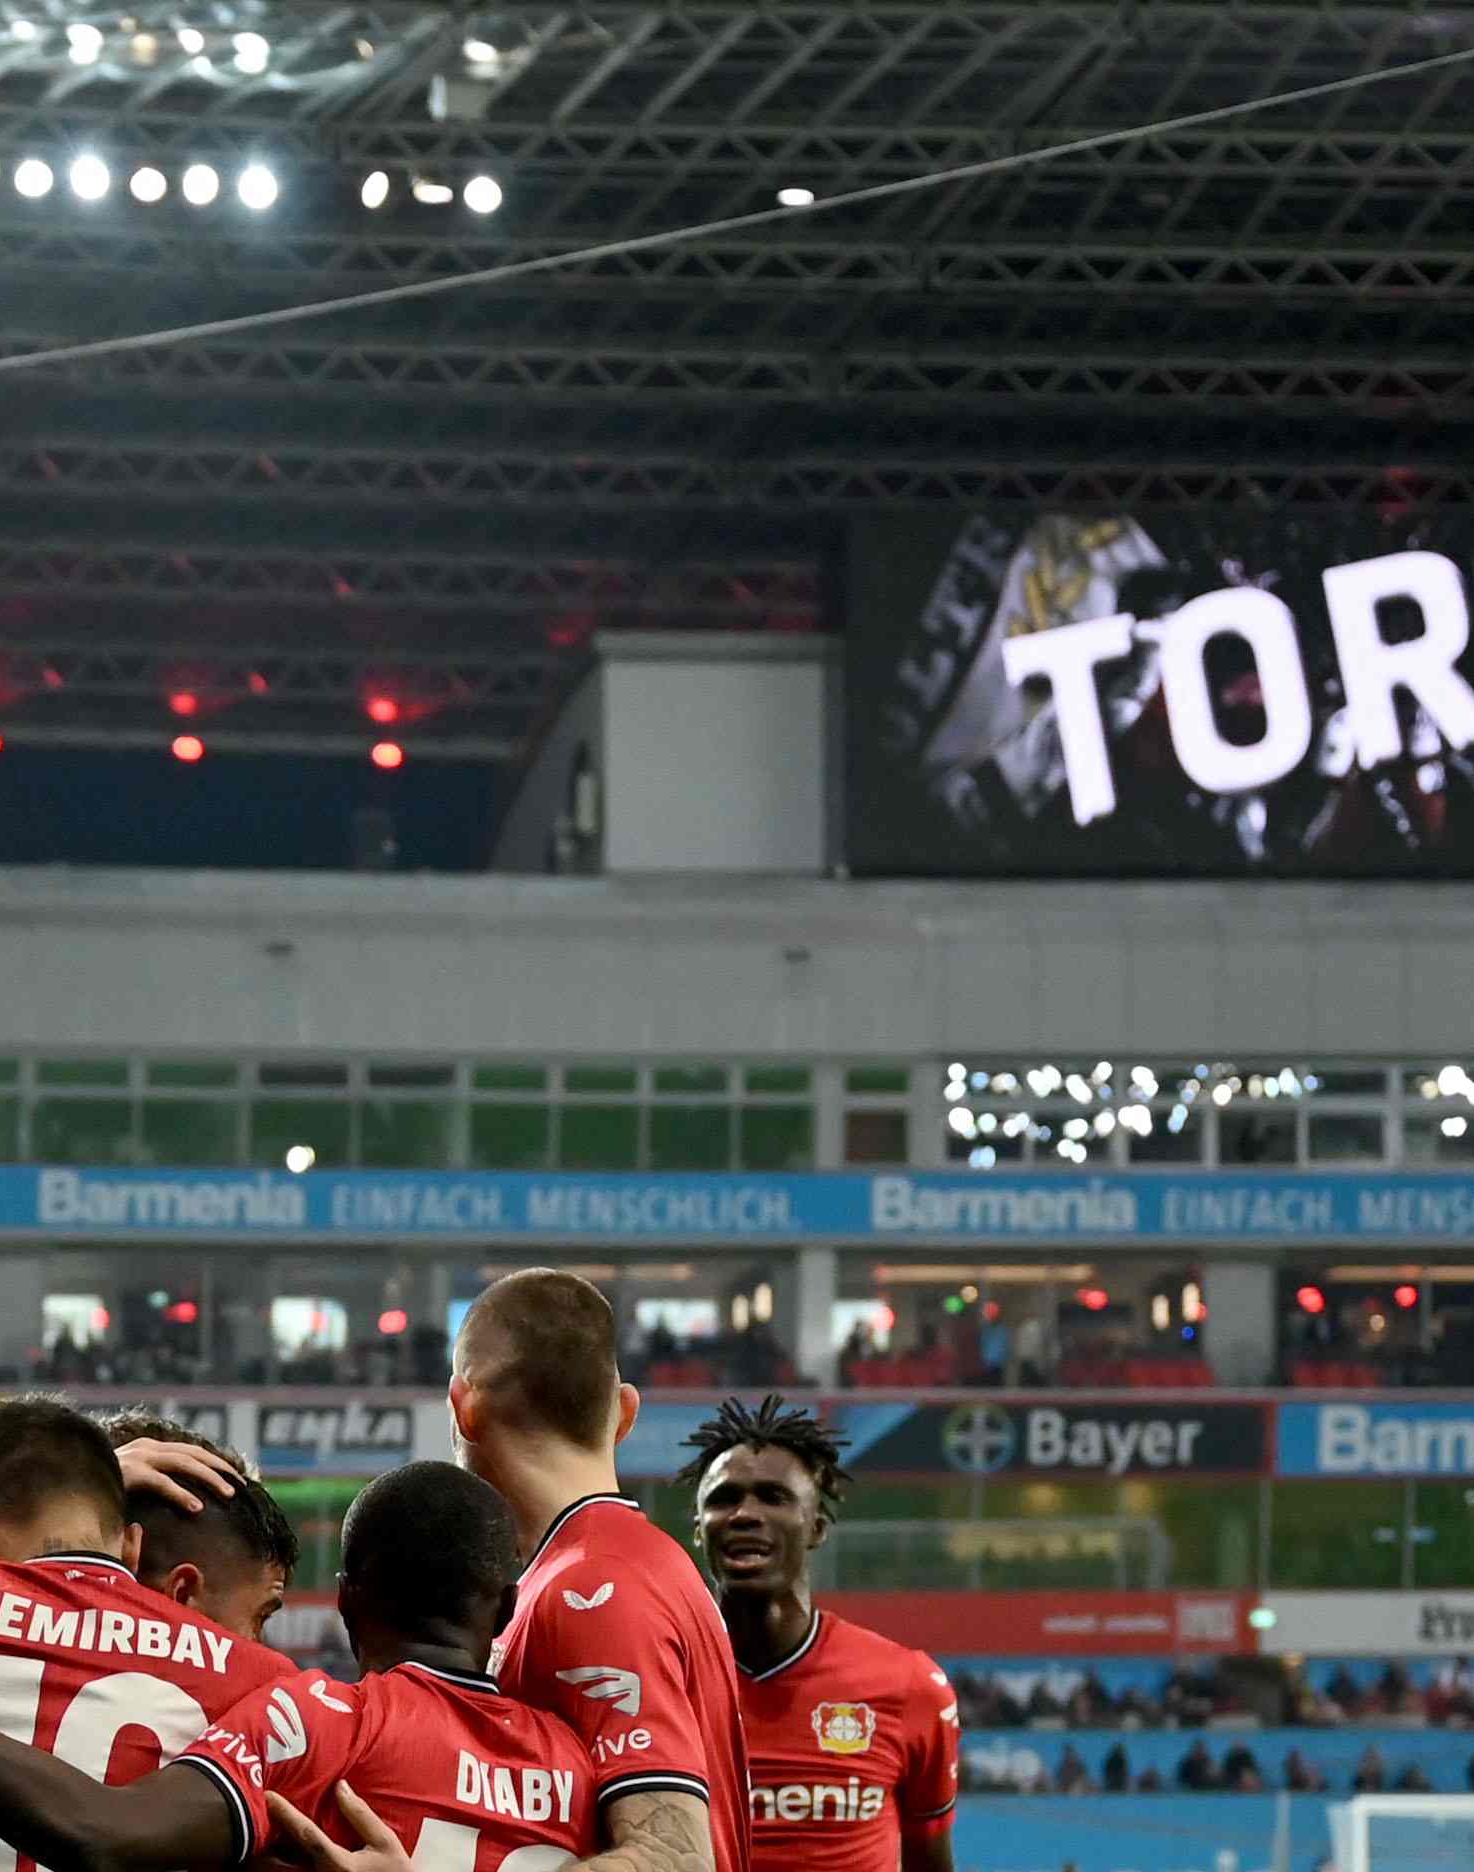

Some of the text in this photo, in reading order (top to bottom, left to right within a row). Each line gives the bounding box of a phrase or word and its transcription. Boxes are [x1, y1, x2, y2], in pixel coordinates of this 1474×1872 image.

[38, 1169, 305, 1226] Barmenia
[332, 1184, 508, 1226] EINFACH.
[871, 1177, 1136, 1231] Barmenia
[1163, 1187, 1347, 1233] EINFACH.
[1026, 1408, 1203, 1470] Bayer
[456, 1750, 574, 1823] DIABY
